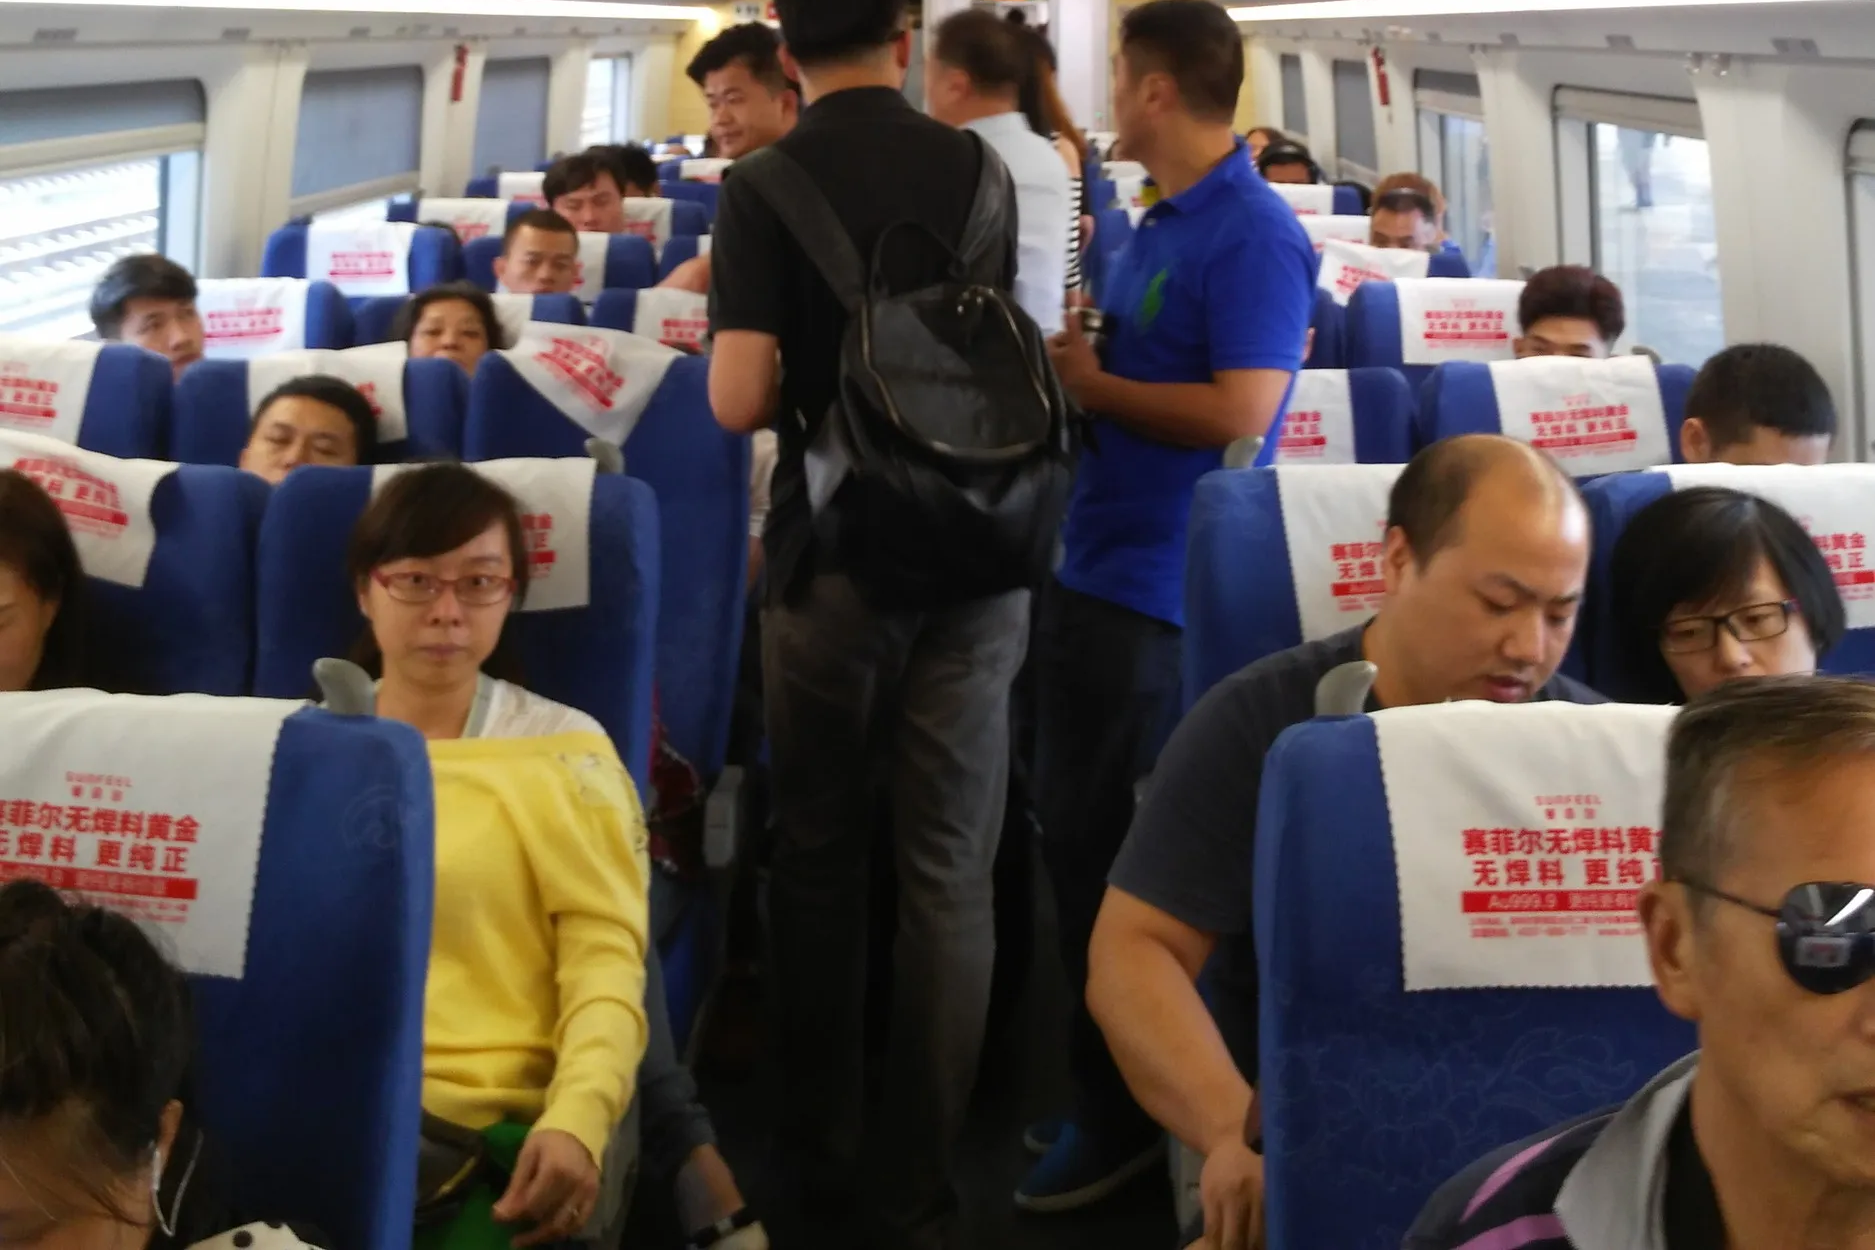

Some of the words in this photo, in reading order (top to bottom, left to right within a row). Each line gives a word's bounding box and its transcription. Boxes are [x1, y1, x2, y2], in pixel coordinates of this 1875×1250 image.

[1461, 826, 1664, 856] 赛菲尔无焊料黄
